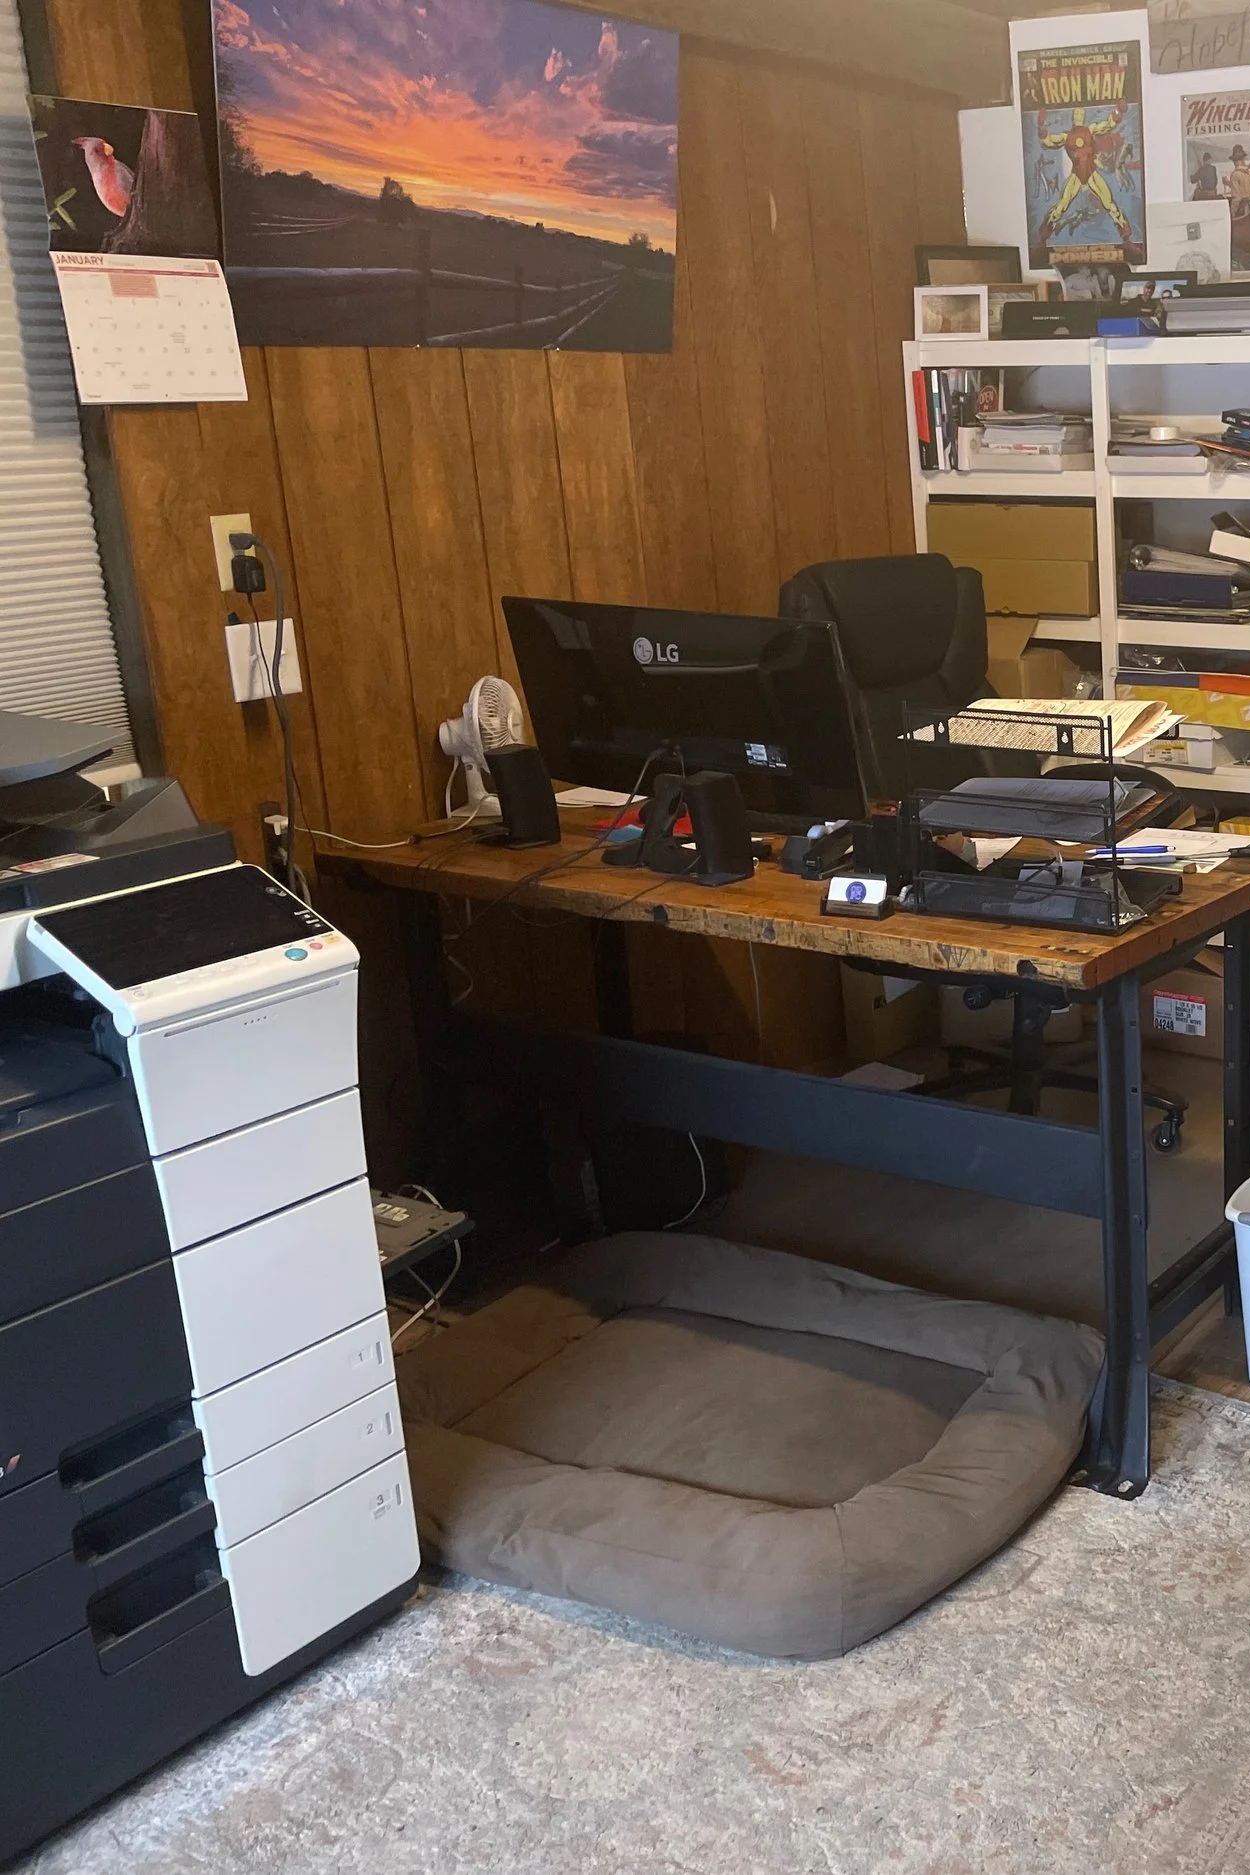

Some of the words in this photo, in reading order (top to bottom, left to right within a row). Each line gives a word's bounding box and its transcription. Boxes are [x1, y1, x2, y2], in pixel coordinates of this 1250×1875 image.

[1041, 58, 1058, 68] THE
[1061, 54, 1114, 67] INVINCIBLE
[1040, 74, 1082, 105] IRON
[1086, 71, 1126, 101] MAN
[1186, 123, 1241, 136] FISHING
[56, 254, 104, 266] JANUARY
[656, 642, 679, 663] LG
[358, 1352, 364, 1362] 1
[366, 1423, 374, 1435] 2
[376, 1494, 384, 1506] 3
